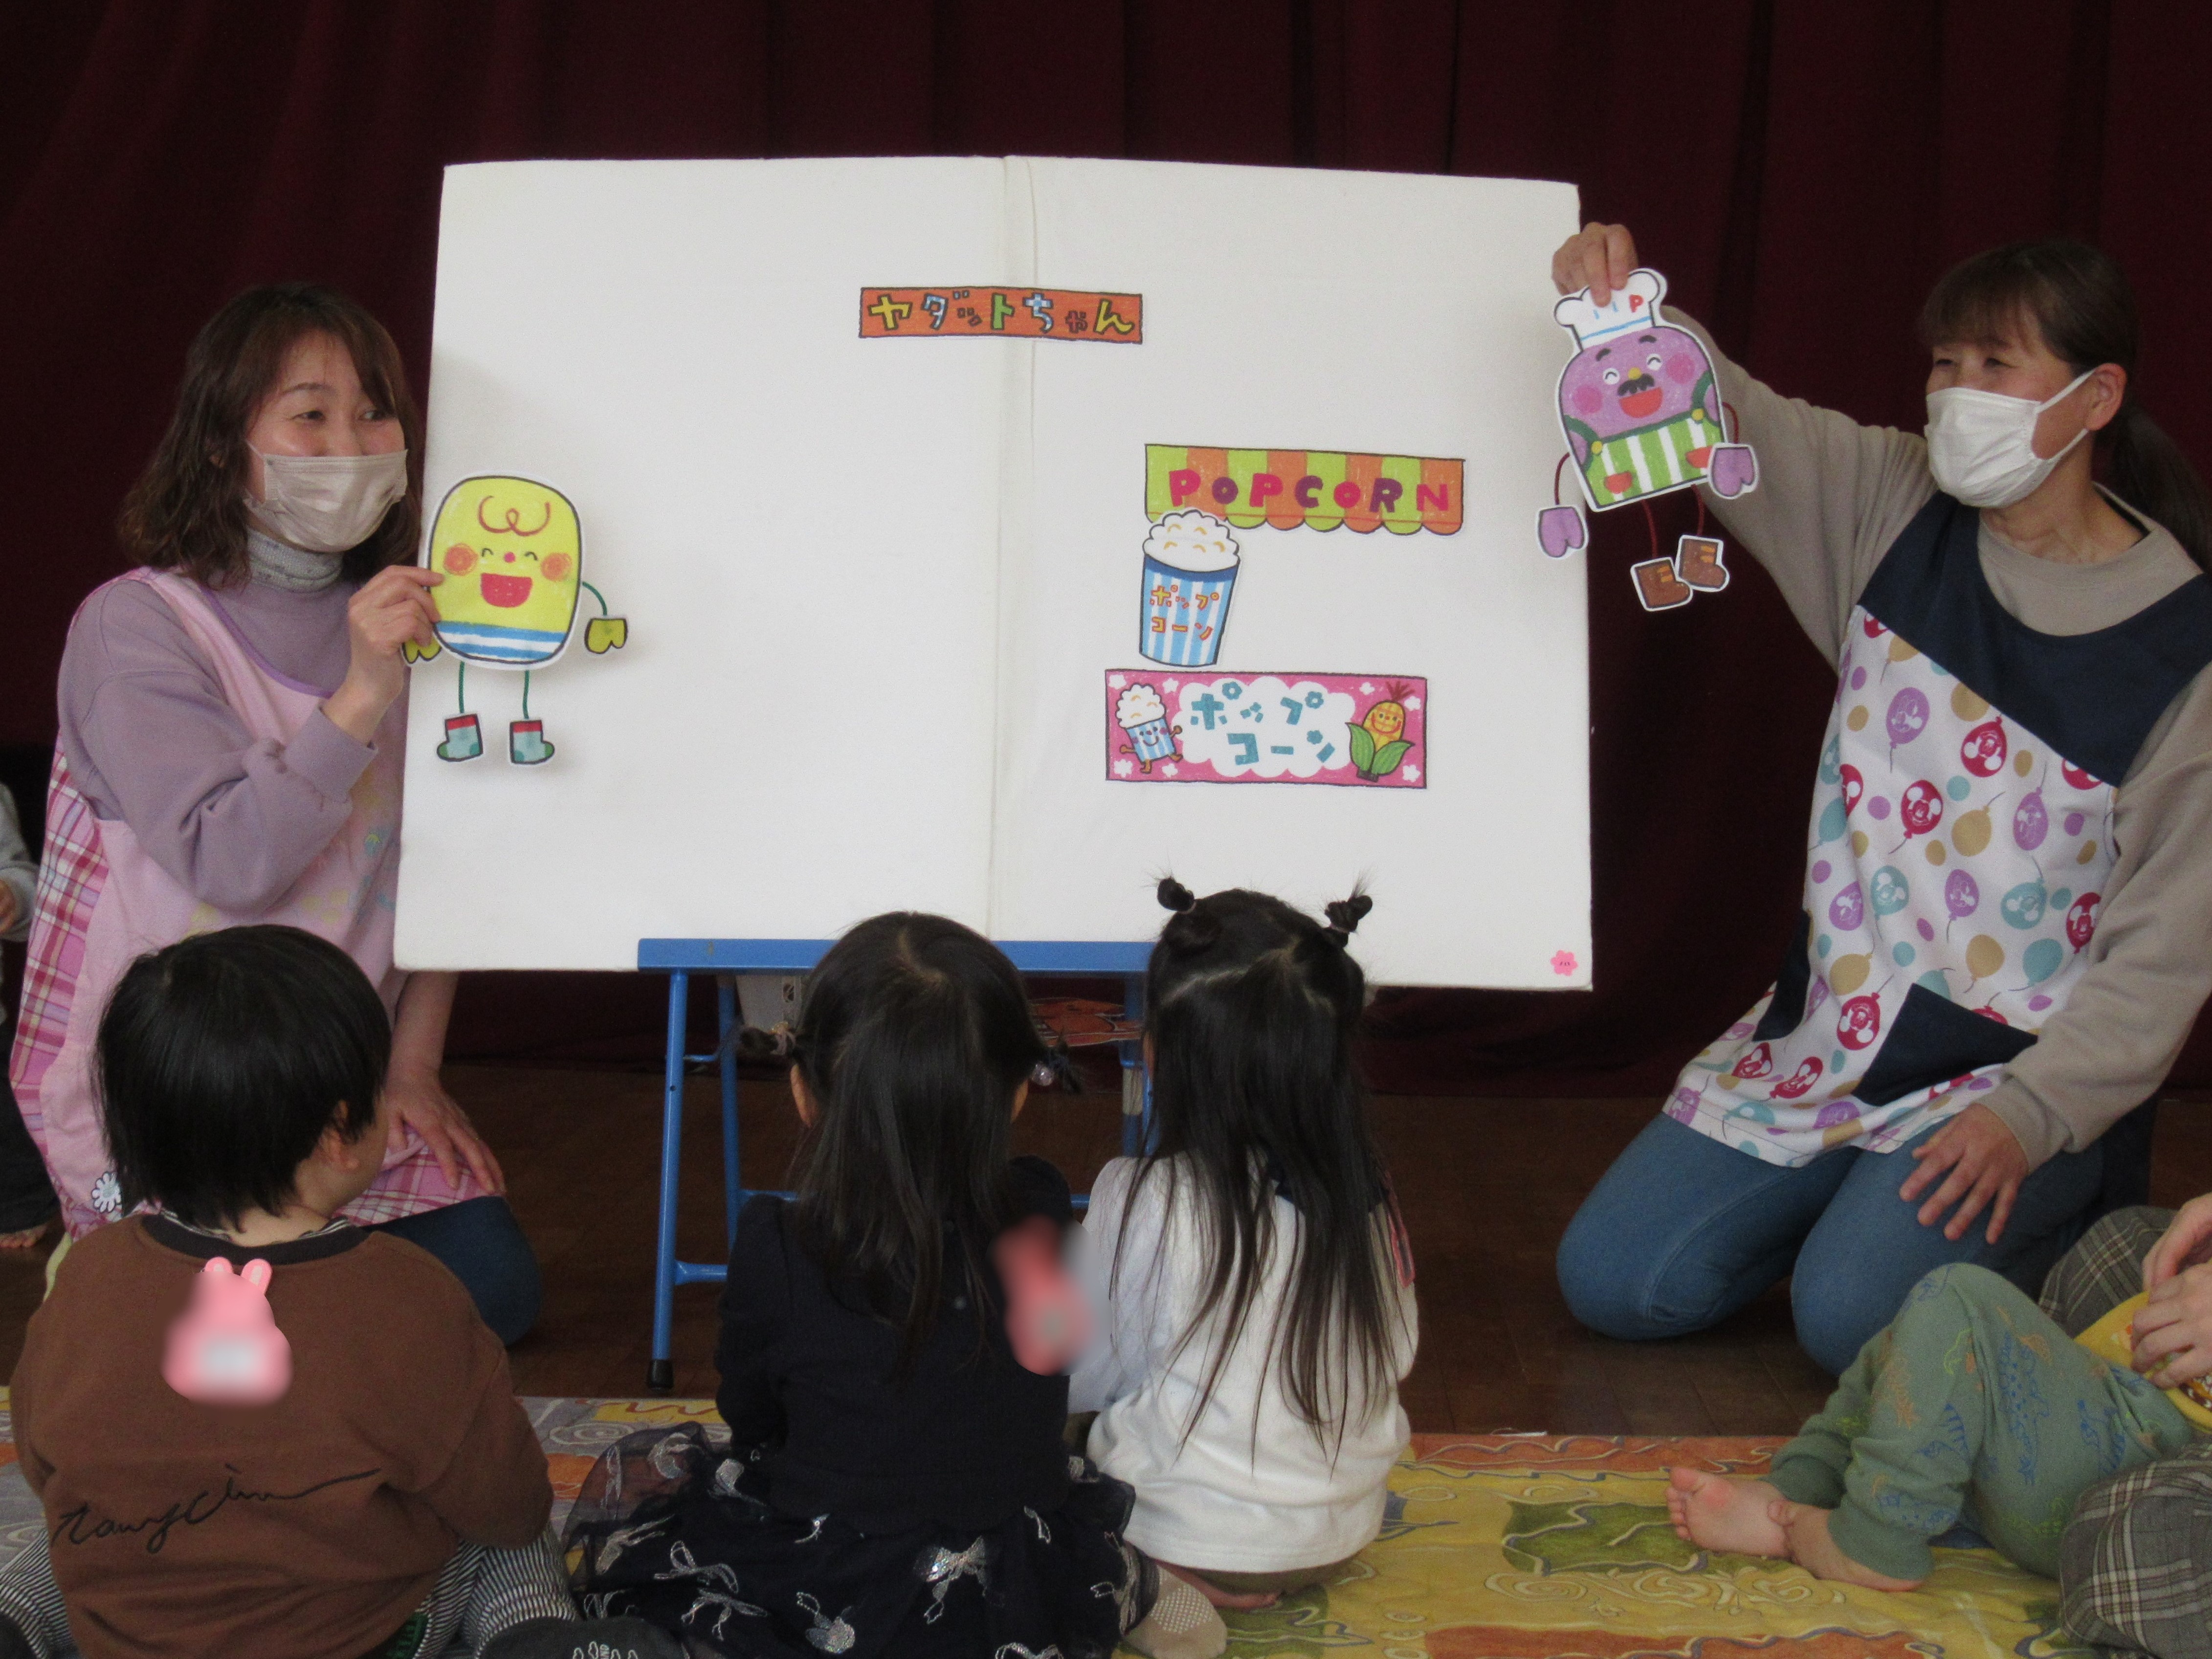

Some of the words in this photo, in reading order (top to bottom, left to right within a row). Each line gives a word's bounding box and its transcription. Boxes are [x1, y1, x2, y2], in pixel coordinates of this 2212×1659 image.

[868, 290, 1135, 335] ヤダットちゃん
[1629, 294, 1644, 313] P
[1169, 468, 1449, 512] POPCORN
[1150, 585, 1220, 611] ポップ
[1151, 616, 1214, 641] コーン
[1190, 681, 1324, 730] ポップ
[1227, 730, 1335, 766] コーン
